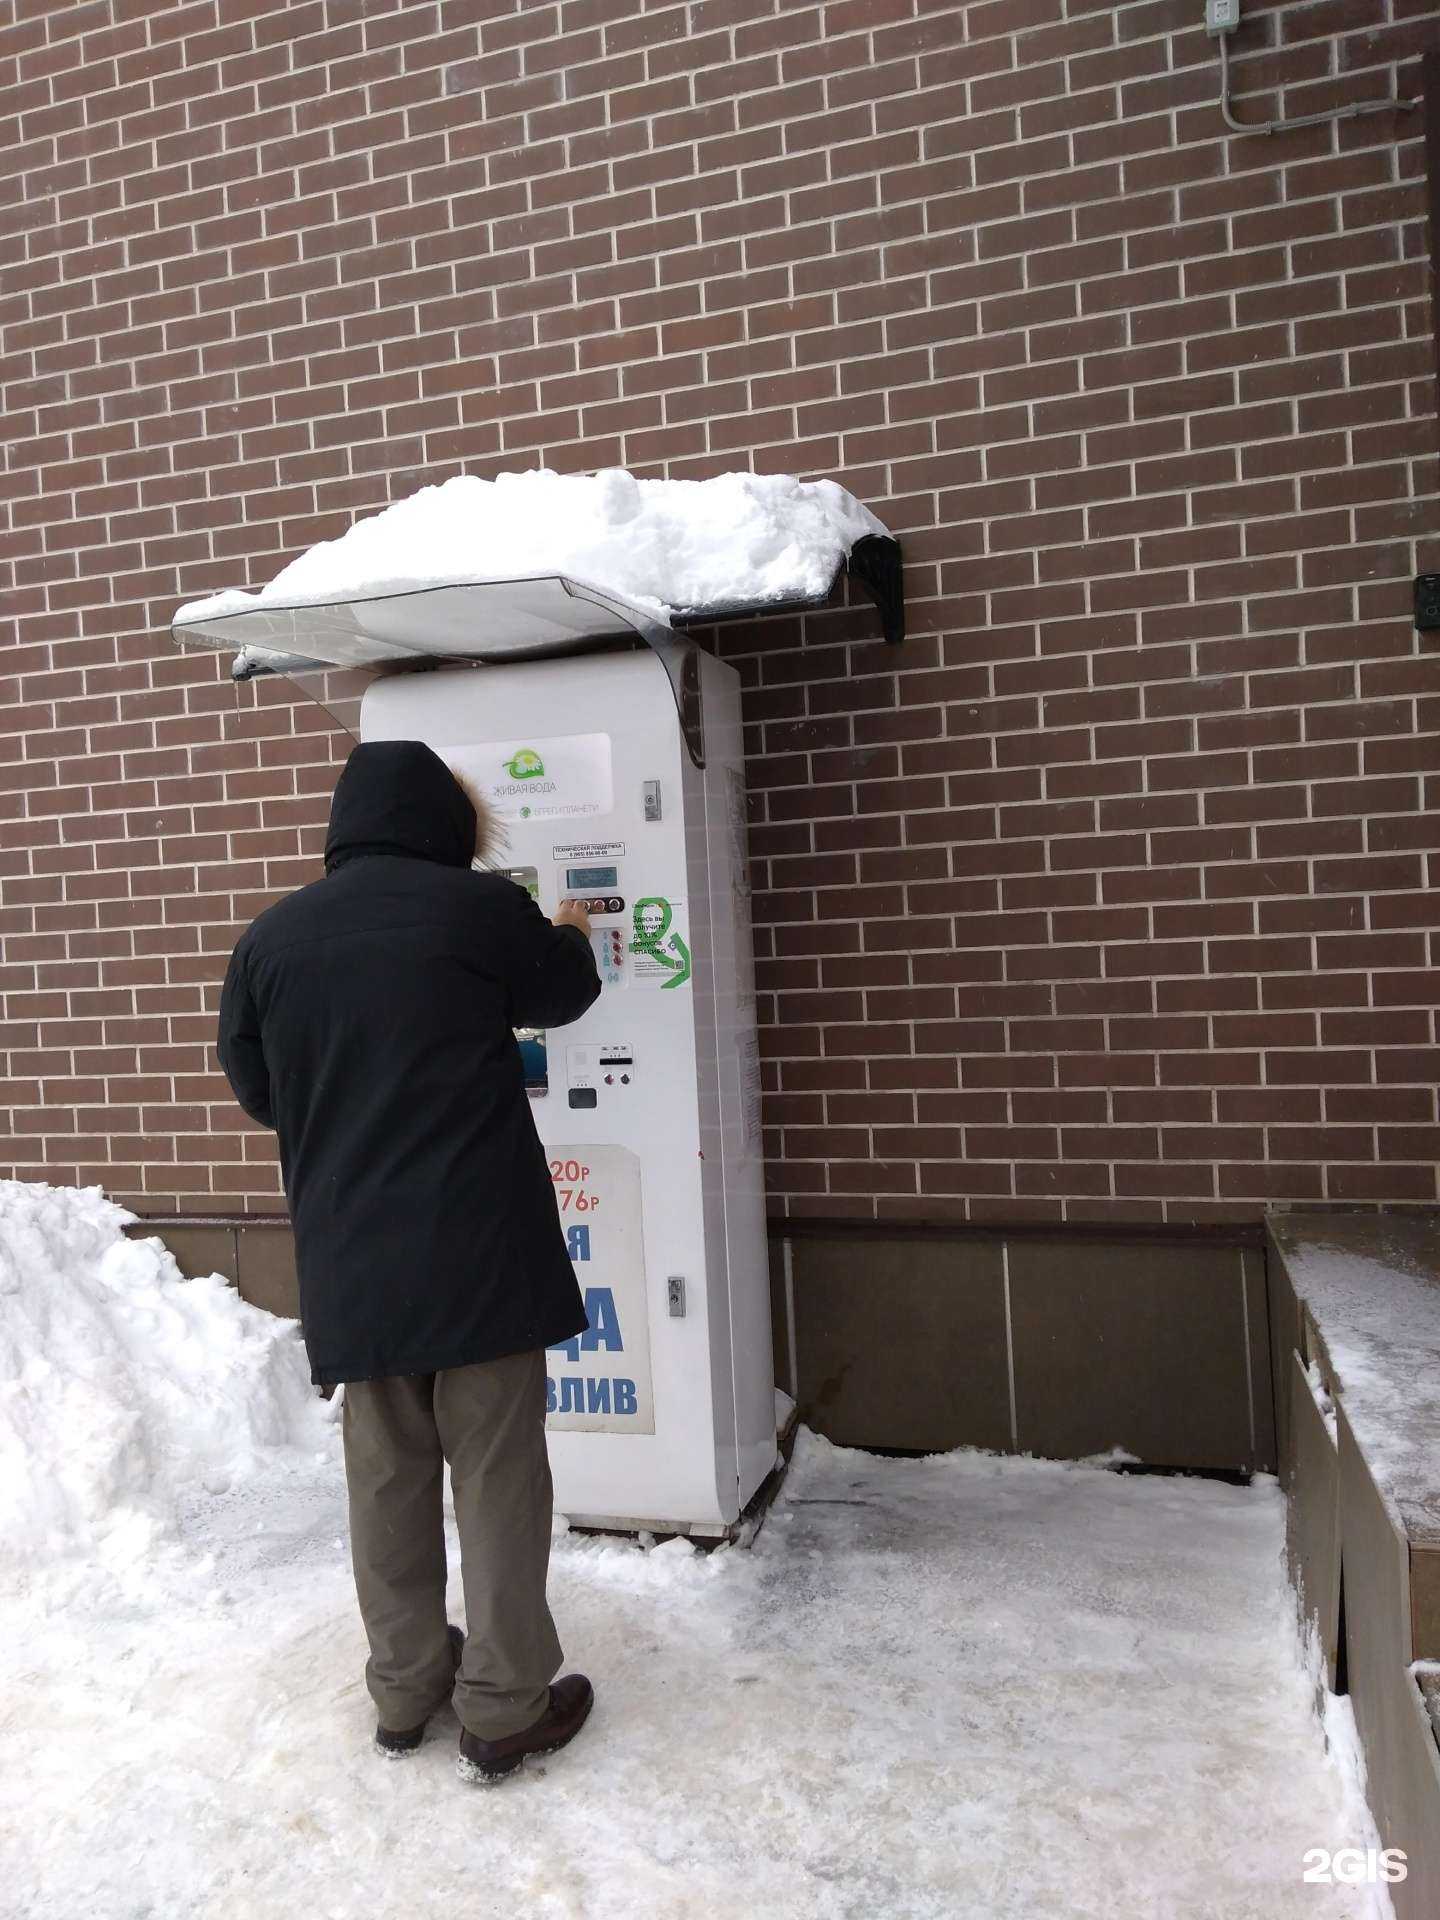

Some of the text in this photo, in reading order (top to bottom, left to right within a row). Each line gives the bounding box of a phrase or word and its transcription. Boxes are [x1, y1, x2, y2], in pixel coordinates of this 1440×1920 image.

[494, 781, 557, 797] ЖИВАЯ ВОДА
[555, 845, 590, 853] ТЕХНИЧЕСКАЯ
[633, 916, 654, 924] Здесь
[633, 939, 662, 948] бонусов
